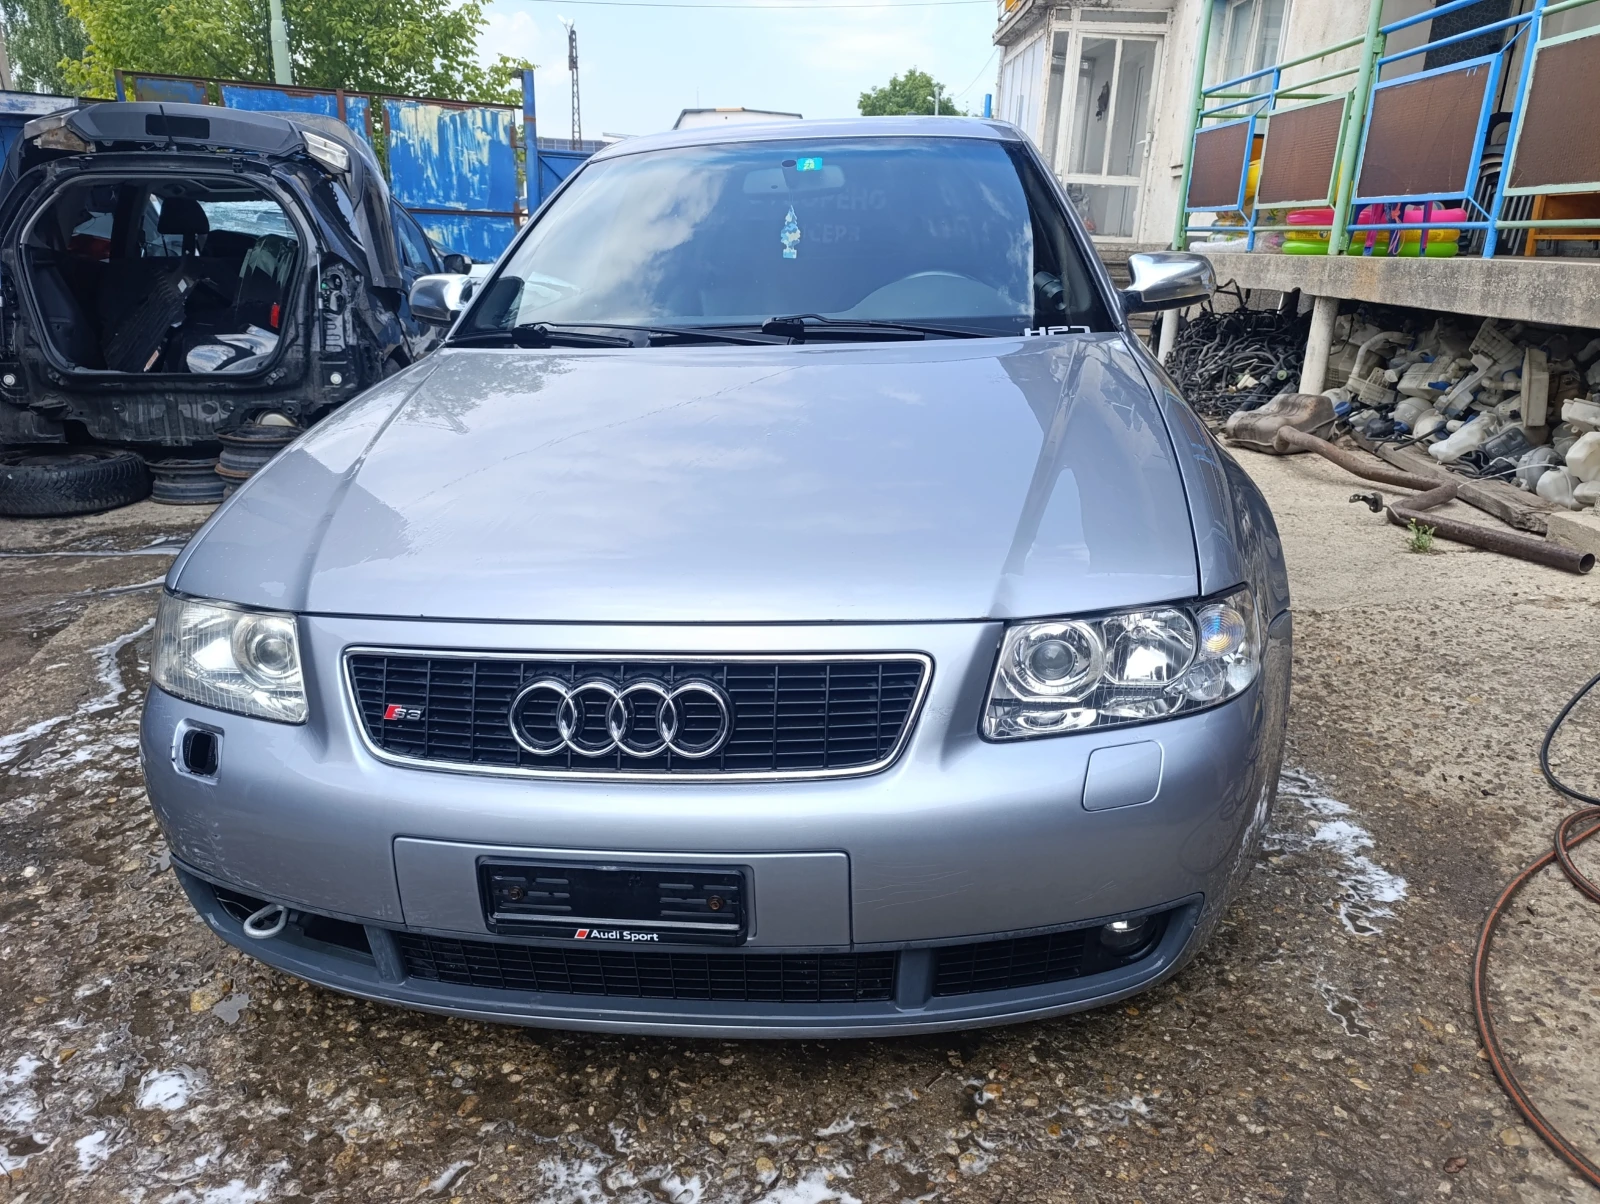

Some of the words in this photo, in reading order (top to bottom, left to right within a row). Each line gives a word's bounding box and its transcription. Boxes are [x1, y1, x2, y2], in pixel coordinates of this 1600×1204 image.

[393, 708, 421, 720] S3
[590, 929, 620, 939] Audi
[623, 931, 659, 942] Sport
